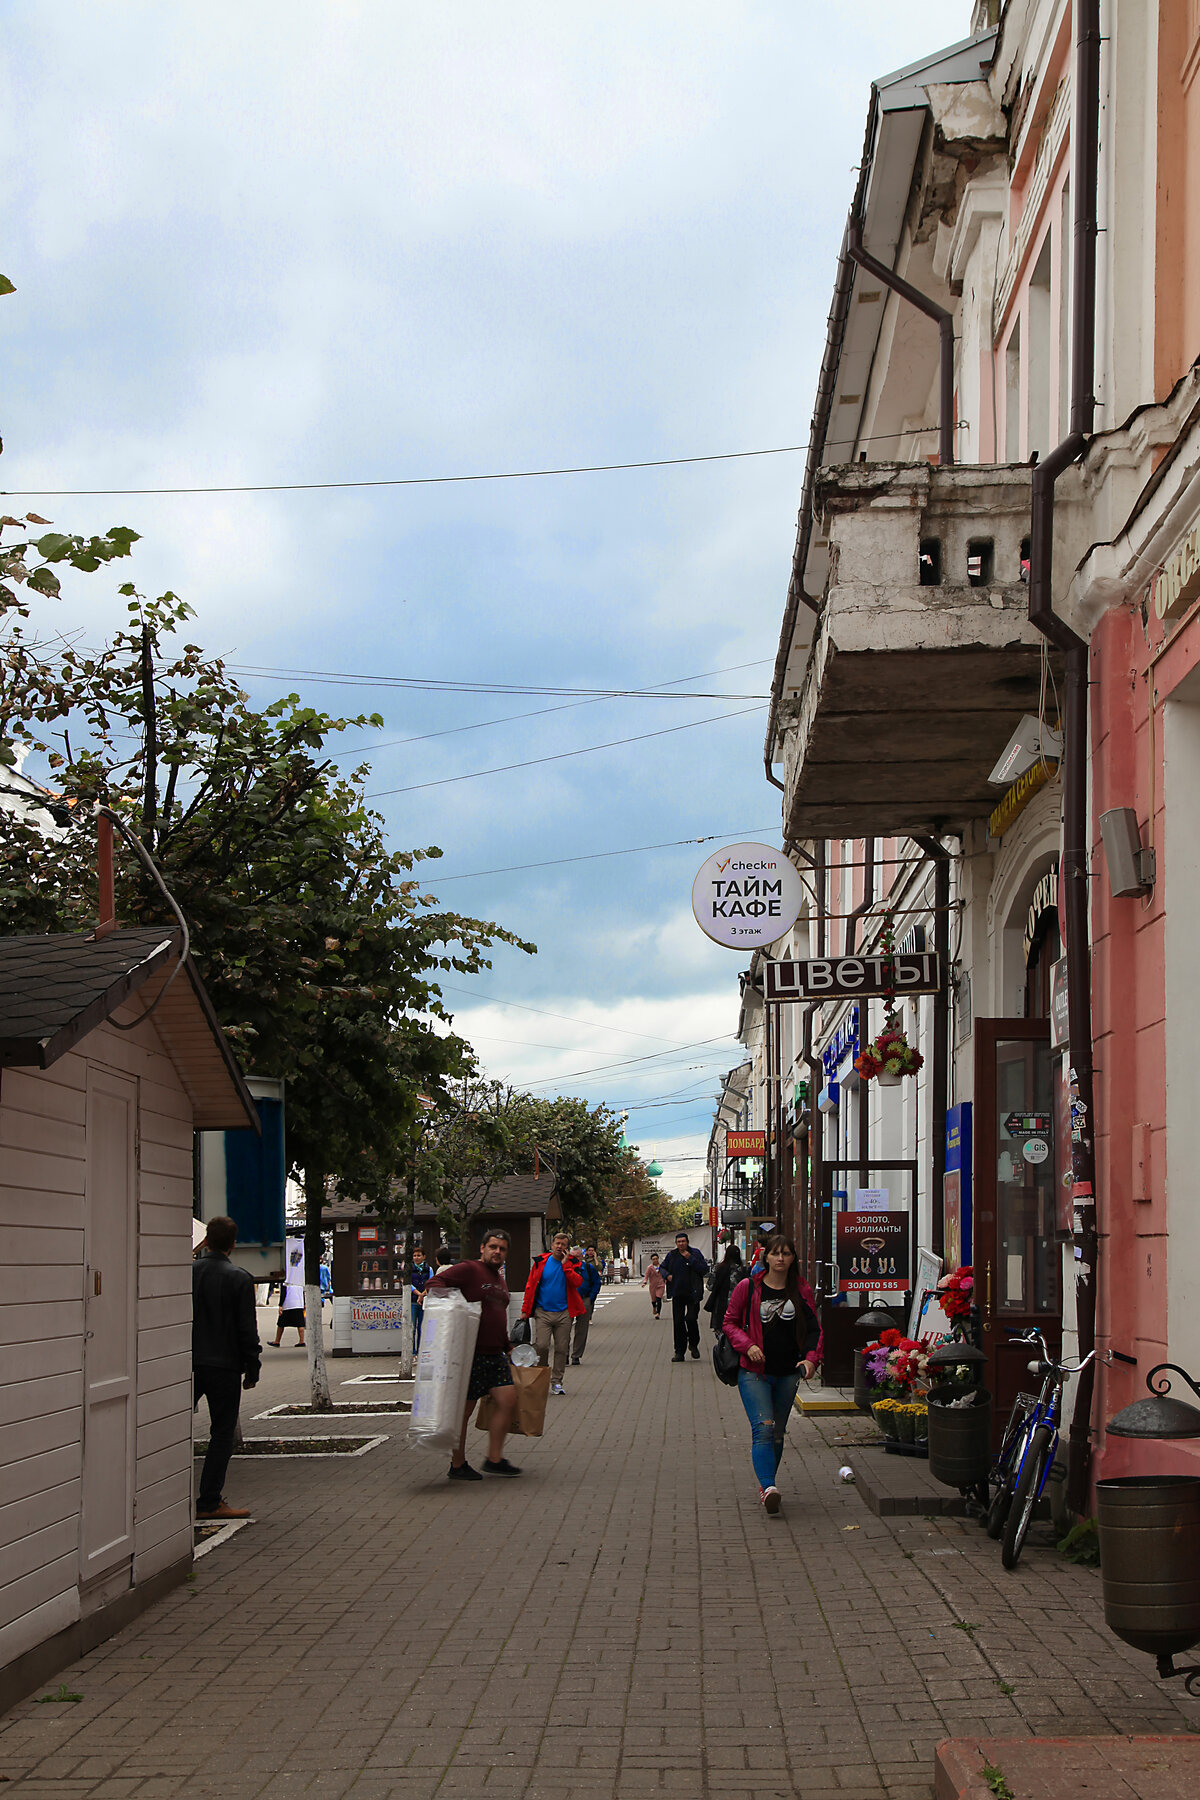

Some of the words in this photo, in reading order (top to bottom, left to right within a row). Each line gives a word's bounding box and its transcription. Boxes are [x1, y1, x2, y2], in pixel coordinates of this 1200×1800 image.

[731, 860, 777, 870] checkin
[711, 875, 782, 897] ТАЙМ
[712, 899, 782, 918] КАФЕ
[730, 927, 737, 935] 3
[738, 927, 762, 935] этаж
[727, 1137, 765, 1150] ЛОМБАРД
[844, 1225, 902, 1234] БРИЛЛИАНТЫ
[847, 1281, 881, 1289] ЗОЛОТО
[882, 1281, 898, 1289] 585
[352, 1308, 398, 1321] Именные
